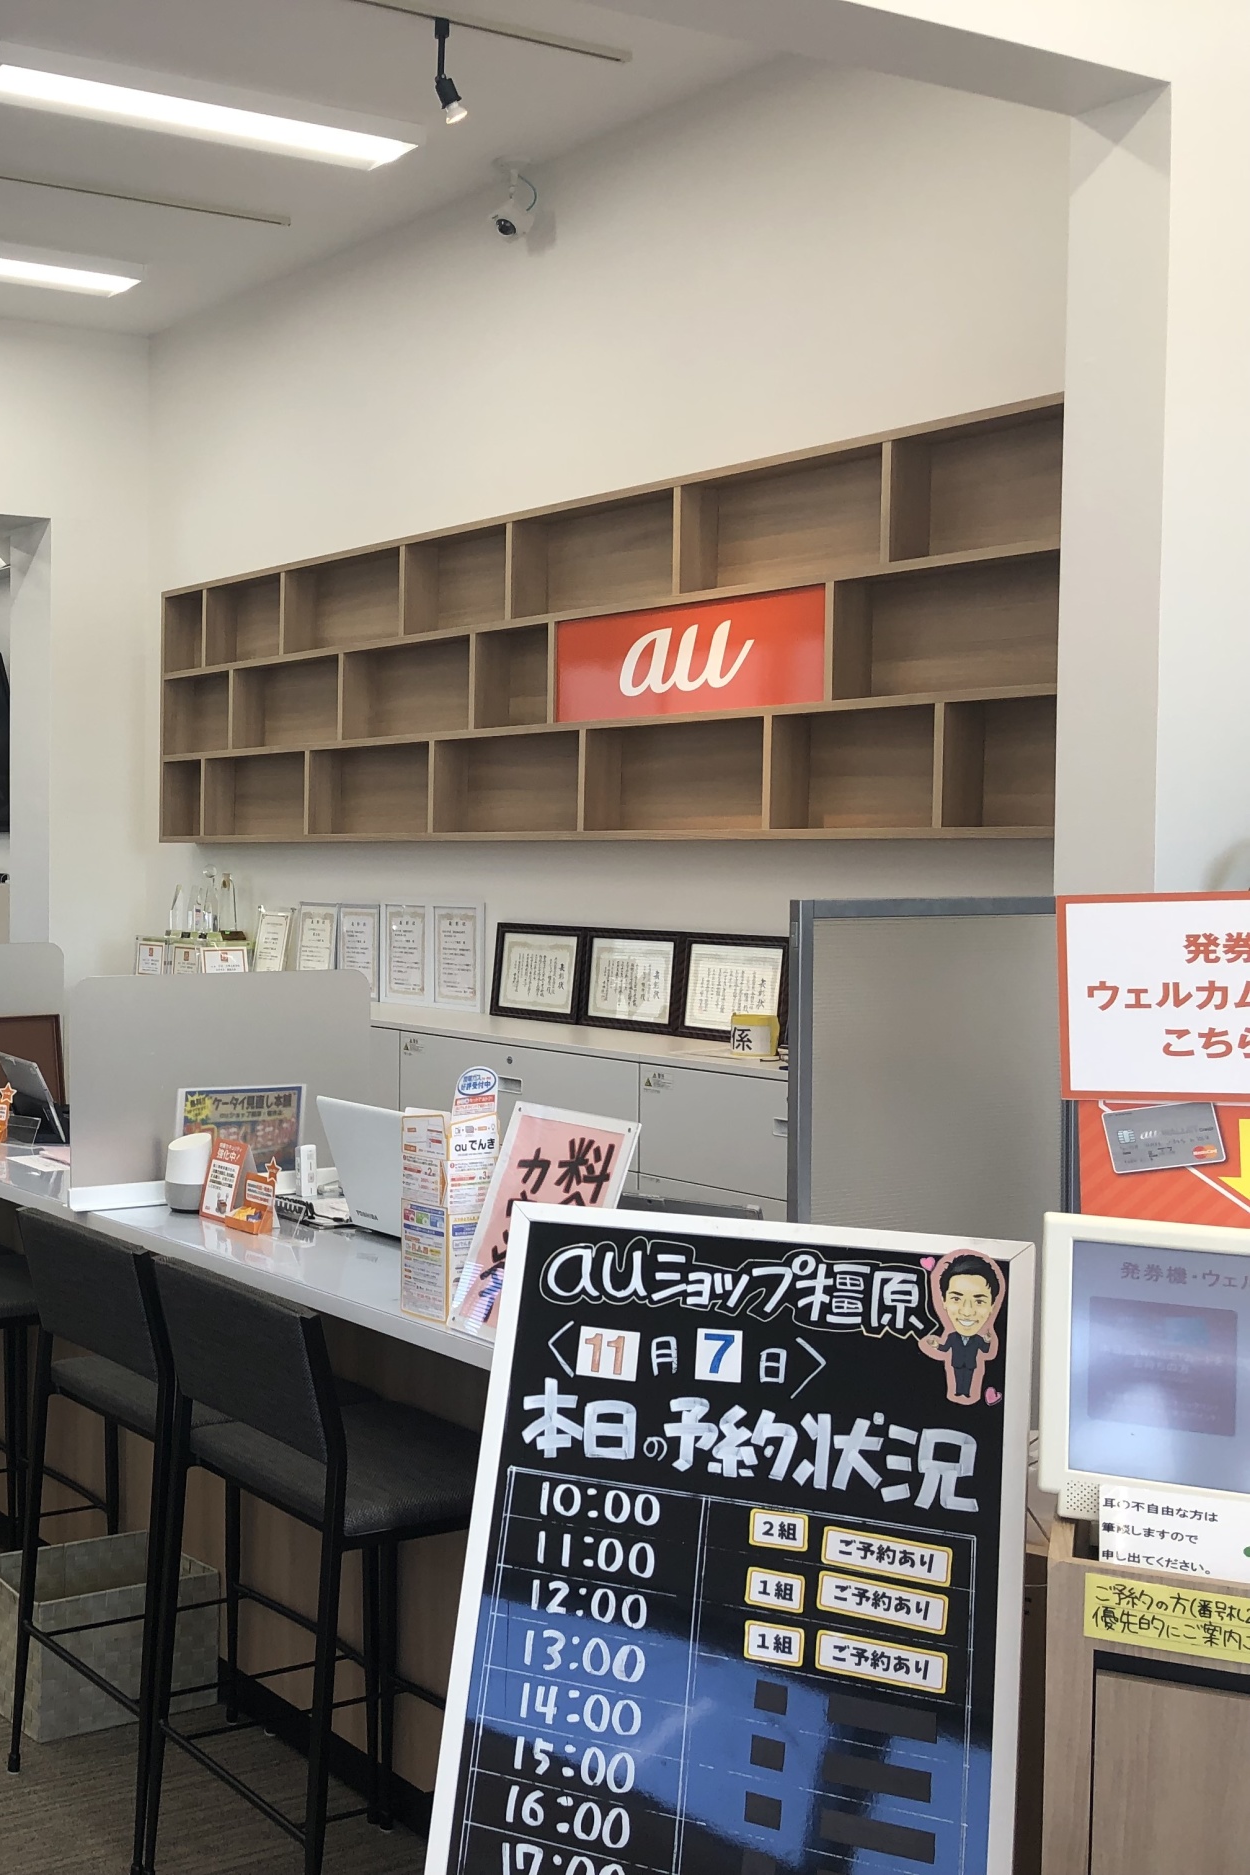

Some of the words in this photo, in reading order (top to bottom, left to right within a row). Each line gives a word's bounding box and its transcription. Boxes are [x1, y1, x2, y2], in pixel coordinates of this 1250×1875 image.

[619, 620, 755, 697] au
[1182, 932, 1250, 965] 発券
[732, 1027, 752, 1051] 係
[454, 1138, 495, 1152] auでんき
[546, 1245, 926, 1333] auショップ橿原
[522, 1378, 980, 1512] 本日の予約状況
[539, 1481, 660, 1526] 10:00
[1102, 1497, 1219, 1522] 耳の不自由な方は
[536, 1531, 655, 1579] 11:00
[761, 1520, 798, 1543] 2組
[839, 1536, 934, 1573] ご予約あり
[1102, 1549, 1210, 1575] 申し出てください。
[531, 1579, 648, 1630] 12:00
[757, 1577, 794, 1603] 1組
[833, 1584, 930, 1620] ご予約あり
[524, 1630, 645, 1683] 13:00
[756, 1631, 794, 1656] 1組
[832, 1644, 930, 1680] ご予約あり
[519, 1682, 642, 1736] 14:00
[513, 1735, 635, 1794] 15:00
[505, 1785, 630, 1849] 16:00
[501, 1842, 626, 1875] 17:0
